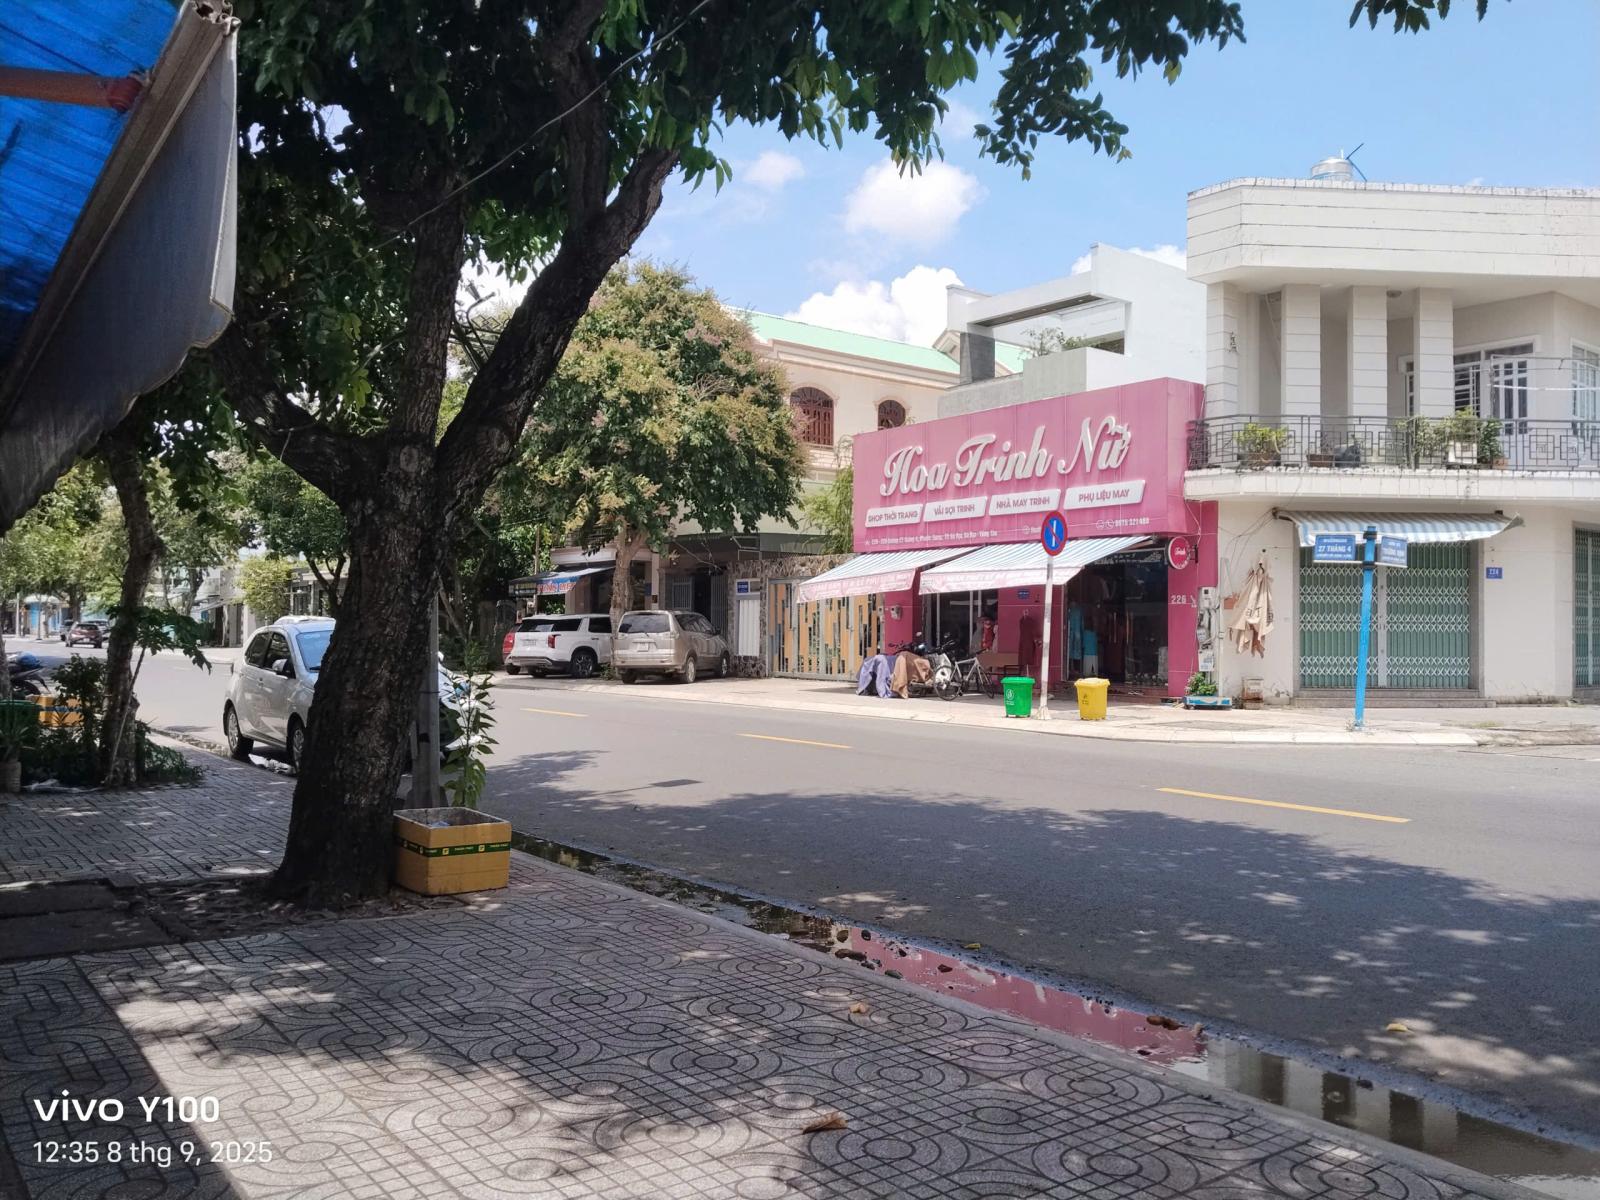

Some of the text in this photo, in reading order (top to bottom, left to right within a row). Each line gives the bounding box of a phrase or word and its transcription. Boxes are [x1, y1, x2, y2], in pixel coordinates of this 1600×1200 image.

[880, 416, 1131, 496] Hoa Trinh Nữ
[1078, 488, 1130, 504] PHỤ LIỆU MAY
[996, 499, 1012, 509] NHÀ
[1012, 498, 1028, 508] MAY
[868, 510, 918, 523] SHOP THỜI TRANG
[1327, 543, 1346, 552] THÁNG
